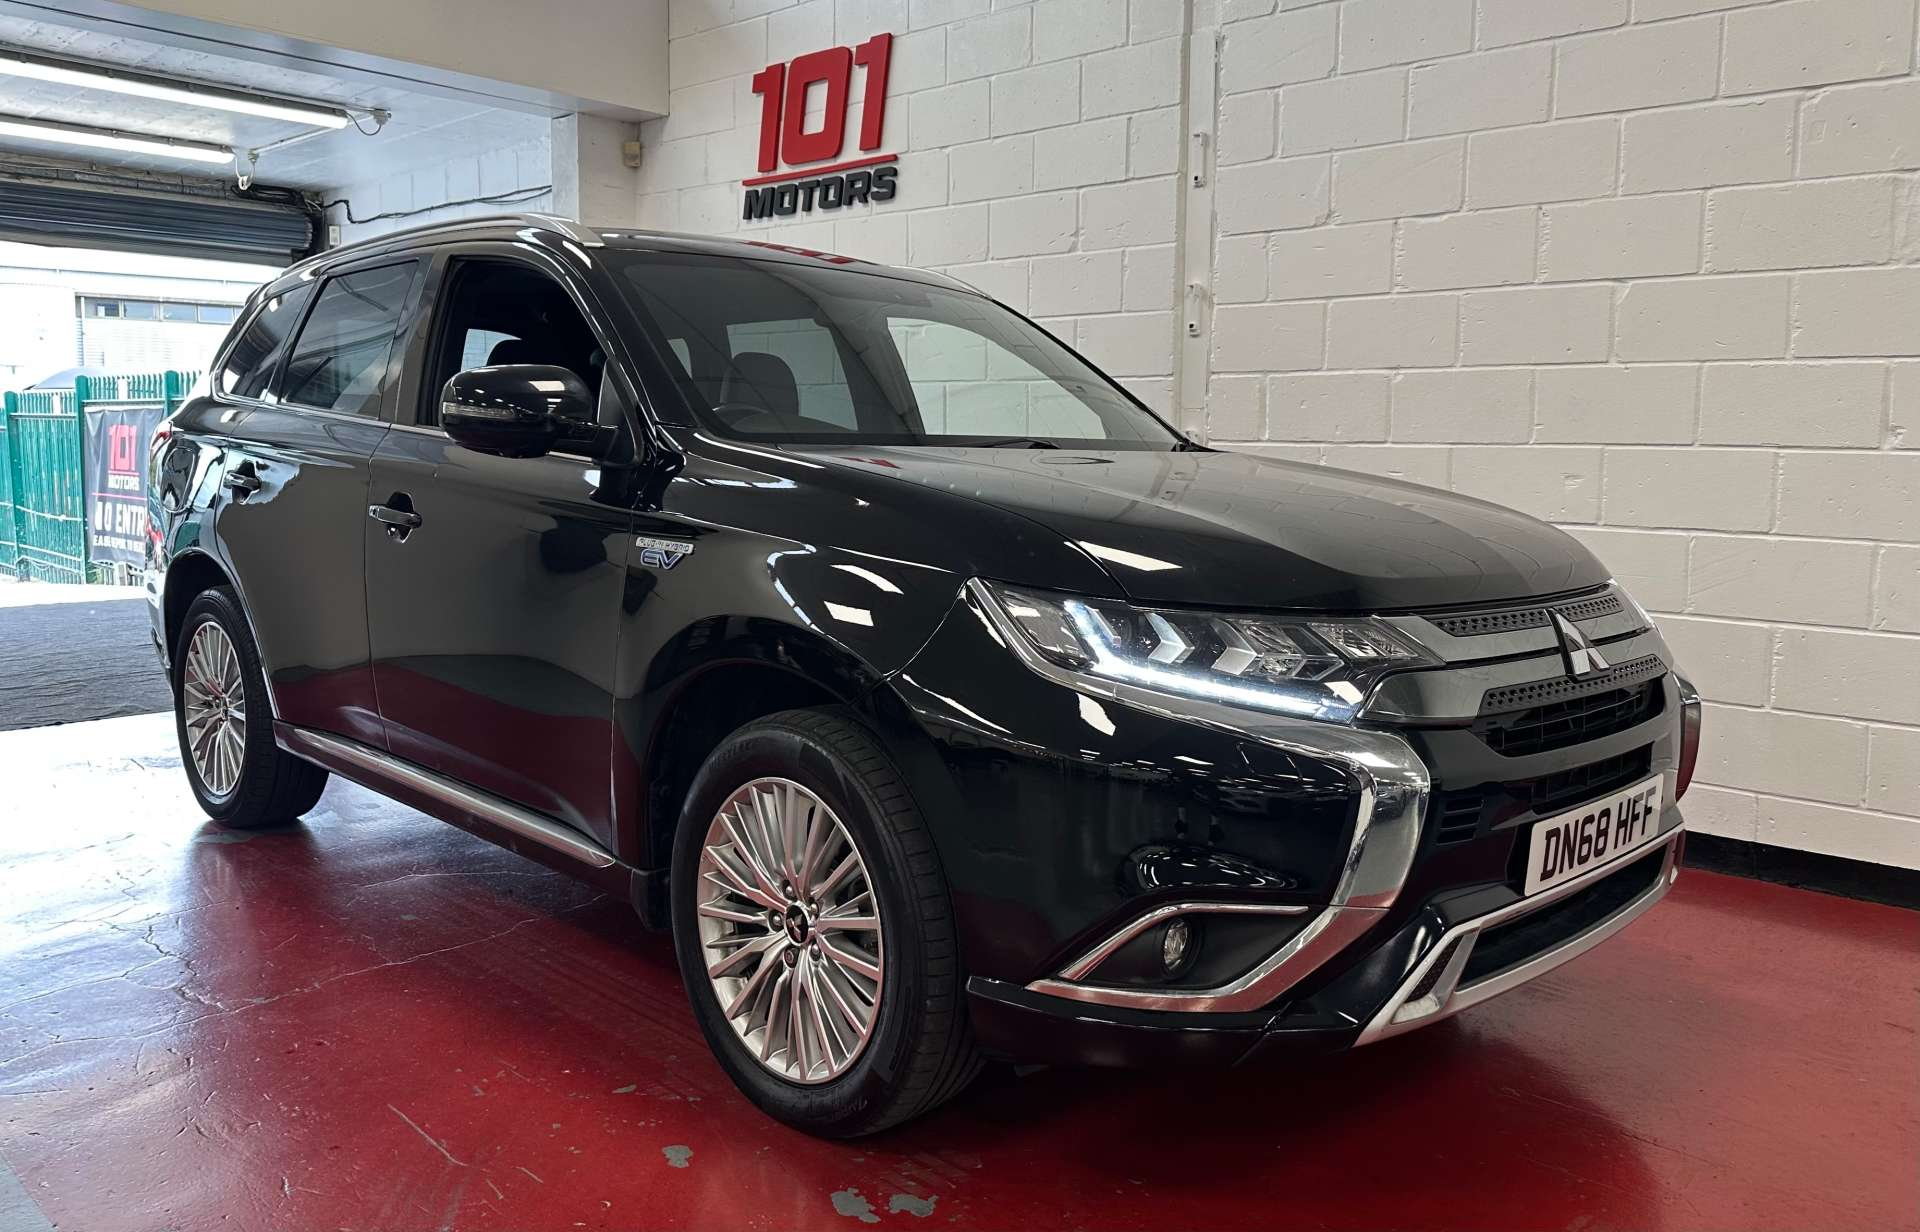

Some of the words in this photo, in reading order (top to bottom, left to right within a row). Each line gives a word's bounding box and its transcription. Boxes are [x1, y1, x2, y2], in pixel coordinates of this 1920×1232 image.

[752, 32, 893, 173] 101
[743, 166, 898, 220] MOTORS
[108, 424, 138, 472] 101
[107, 474, 140, 492] MOTORS
[115, 503, 148, 537] ENTR
[640, 548, 683, 569] EV
[1540, 807, 1611, 882] DN68
[1614, 786, 1657, 850] HFF
